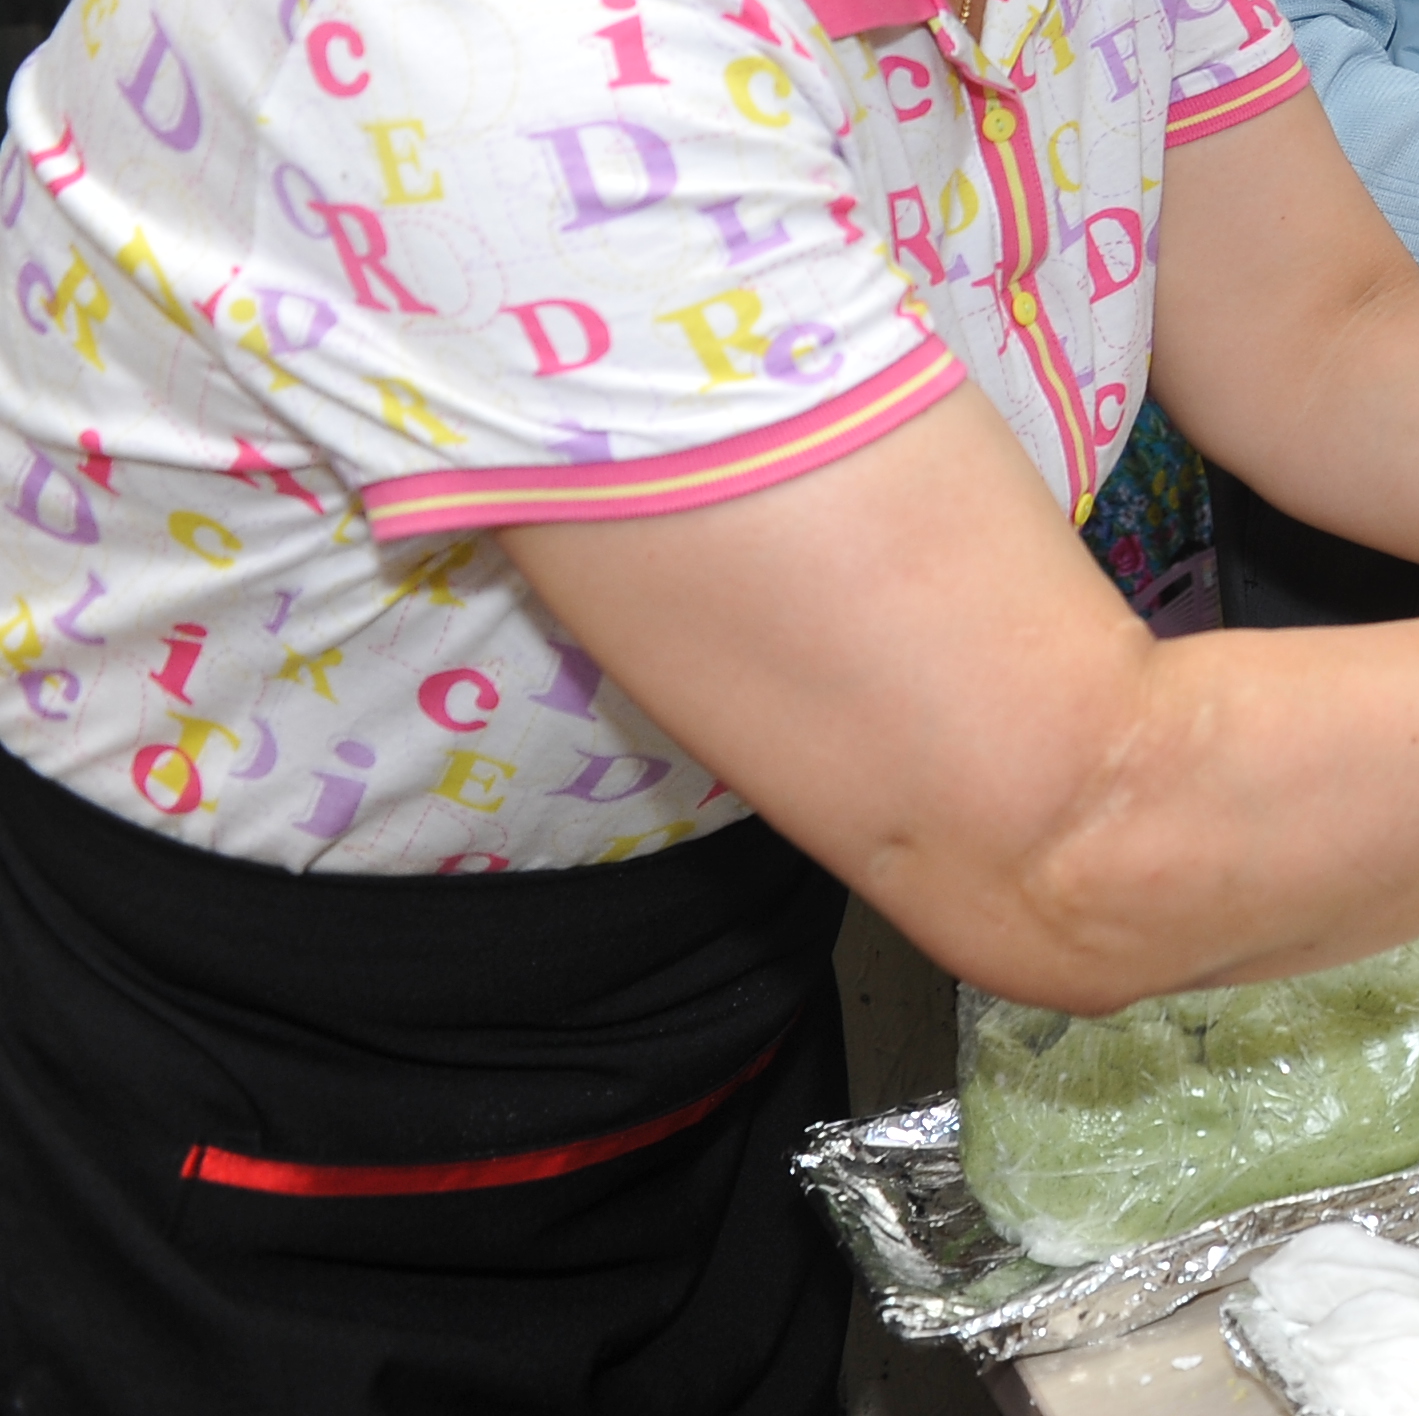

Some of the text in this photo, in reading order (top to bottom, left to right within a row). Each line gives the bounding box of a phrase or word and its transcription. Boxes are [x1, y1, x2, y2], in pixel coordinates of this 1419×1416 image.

[116, 8, 202, 152] D
[362, 117, 445, 206] E
[519, 118, 678, 233] D
[306, 199, 439, 316] R
[698, 196, 792, 267] L
[886, 185, 946, 288] R
[1085, 206, 1142, 306] D
[500, 297, 613, 378] D
[653, 287, 773, 395] R
[3, 442, 102, 546] D
[148, 621, 209, 707] i
[429, 748, 518, 814] E
[544, 748, 673, 804] D
